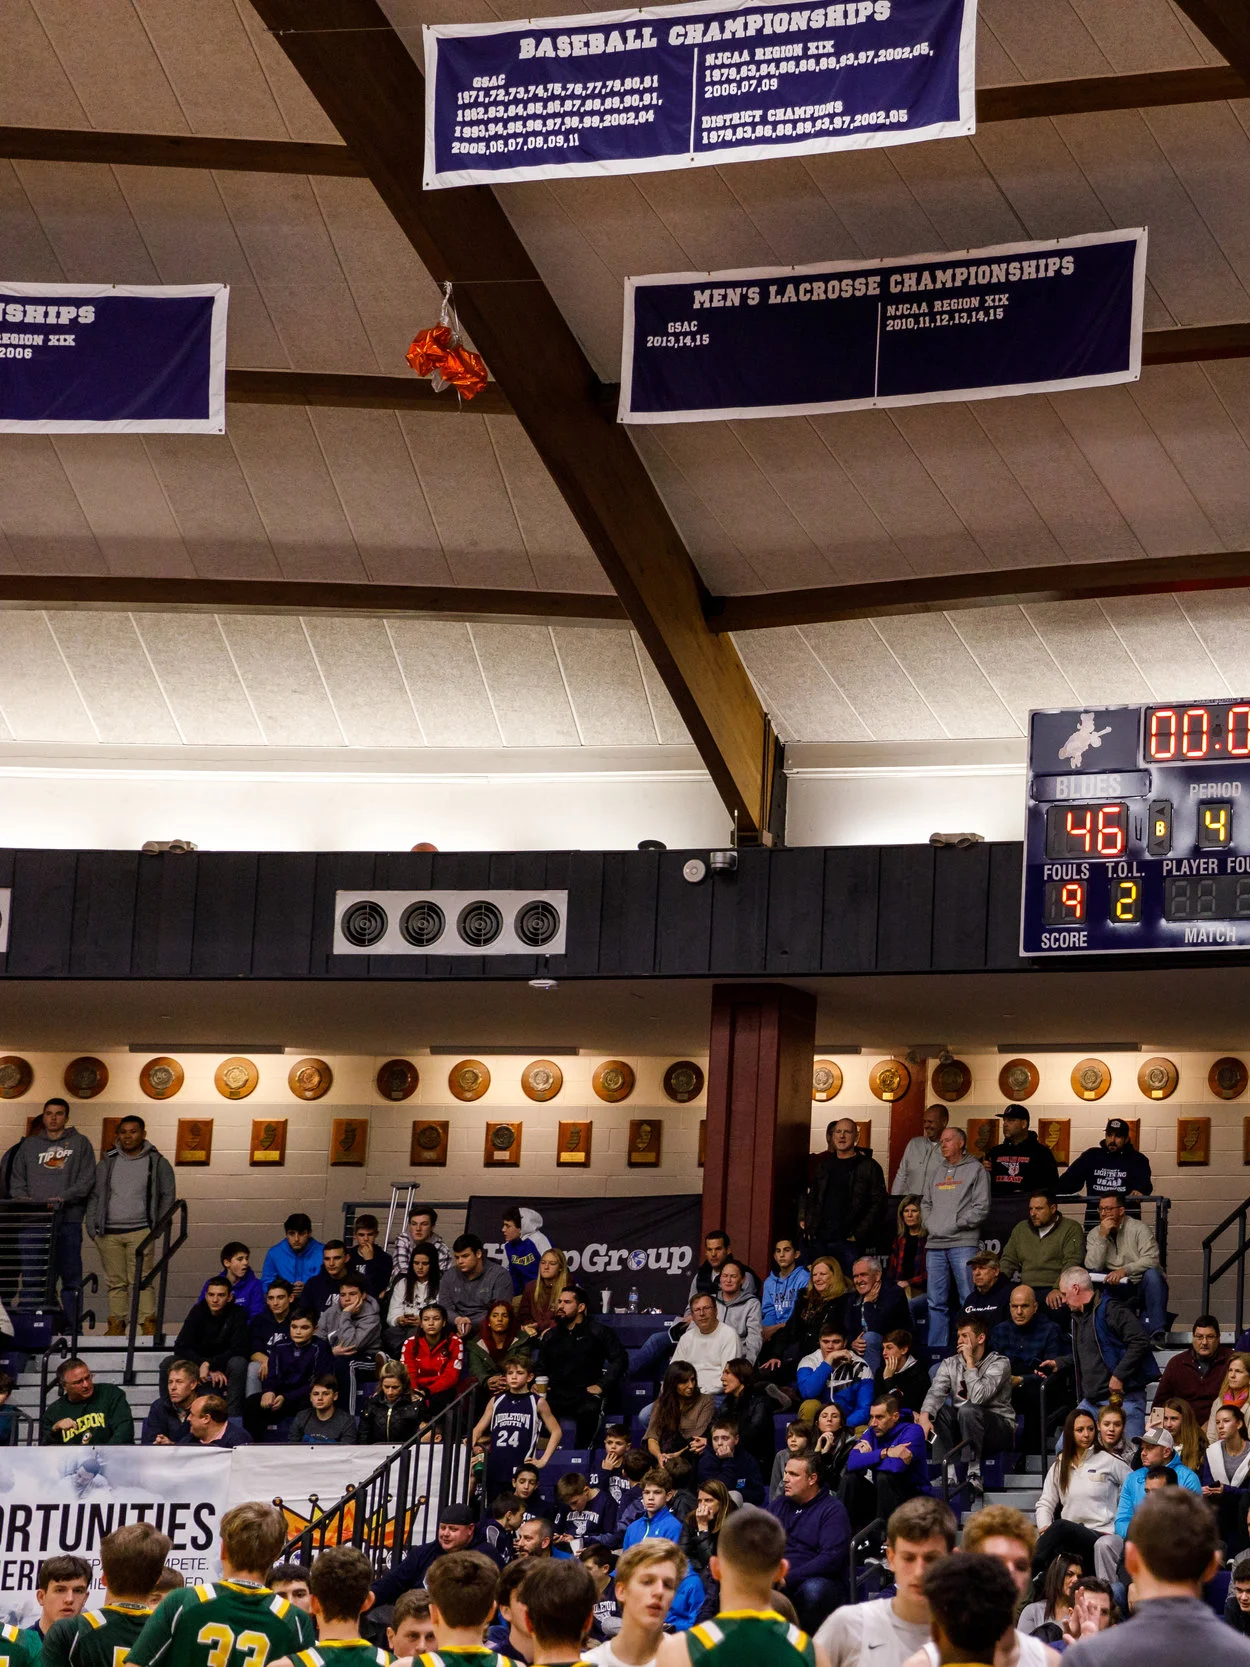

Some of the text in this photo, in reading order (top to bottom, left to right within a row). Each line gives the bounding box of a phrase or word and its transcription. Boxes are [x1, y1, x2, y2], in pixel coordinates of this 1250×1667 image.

[518, 0, 892, 60] BASEBALL CHAMPIONSHIPS
[705, 40, 835, 67] NJCAA REGION XIX
[473, 74, 505, 88] GSAC
[704, 77, 778, 98] 2006,07,09
[701, 100, 843, 129] DISTRICT CHAMPIONS
[451, 133, 580, 155] 2005,06,07,08,09,11
[693, 255, 1075, 309] MEN'S LACROSSE CHAMPIONSHIPS
[887, 293, 1010, 317] NJCAA REGION XIX
[667, 320, 698, 334] GSAC
[885, 308, 1004, 331] 2010,11,12,13,14,15
[48, 335, 76, 346] XIX
[646, 333, 710, 348] 2013,14,15
[1056, 774, 1121, 799] BLUES
[1189, 781, 1242, 800] PERIOD
[1066, 806, 1123, 855] 46
[1204, 809, 1226, 841] 4
[1044, 863, 1090, 880] FOULS
[1106, 861, 1145, 878] T.O.L.
[1163, 858, 1218, 875] PLAYER
[1062, 883, 1082, 919] 9
[1116, 882, 1136, 919] 2
[1041, 931, 1088, 949] SCORE
[1184, 926, 1237, 944] MATCH
[38, 1150, 73, 1165] TIP OFF
[496, 1430, 519, 1447] 24
[0, 1502, 216, 1552] RTUNITIES
